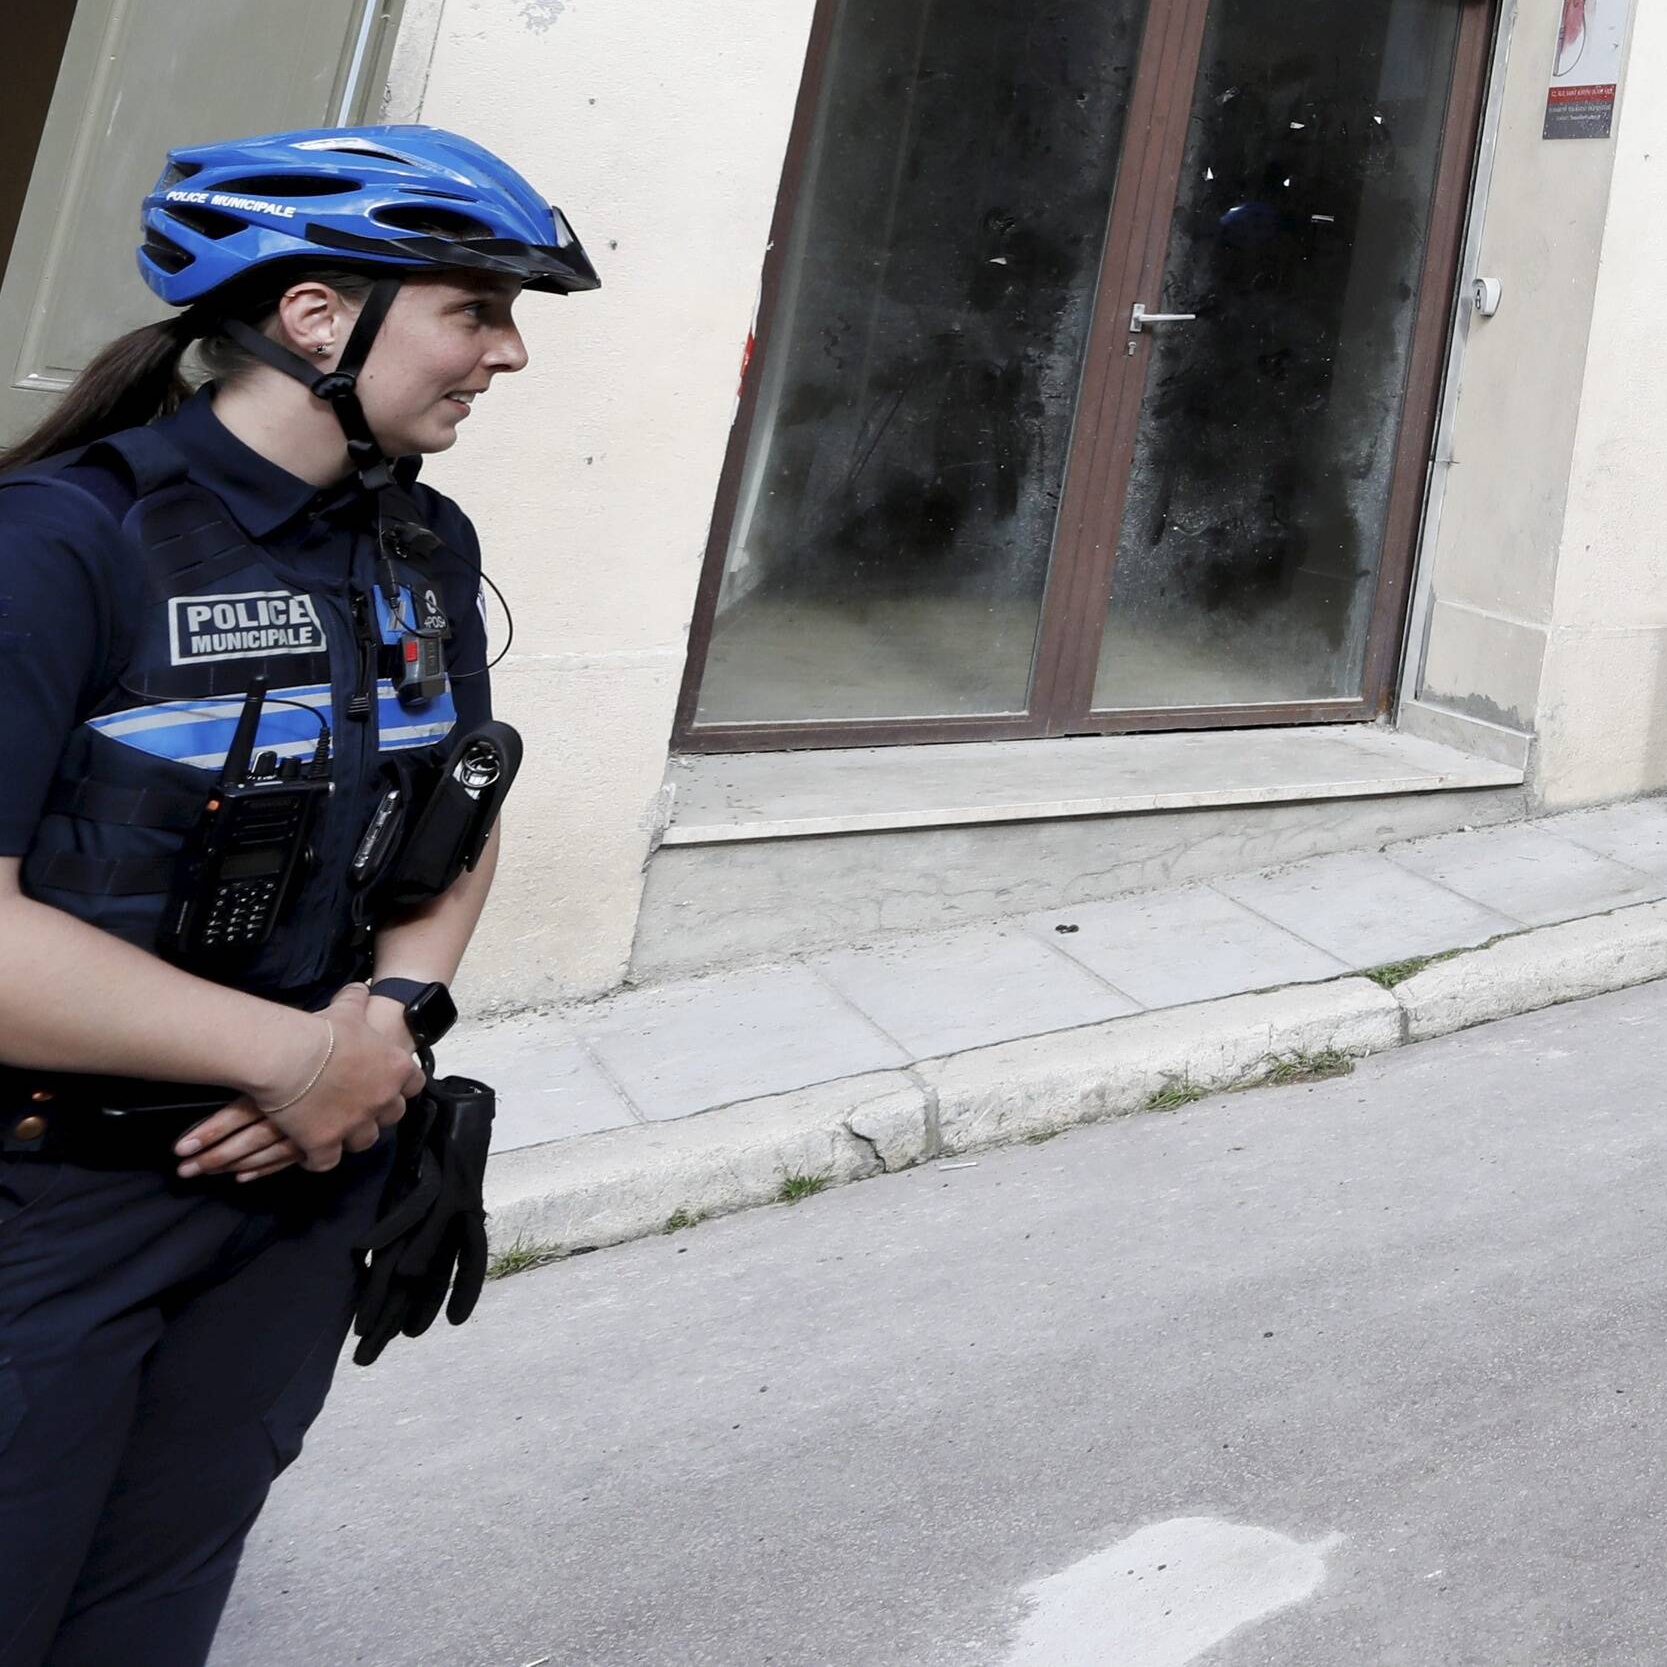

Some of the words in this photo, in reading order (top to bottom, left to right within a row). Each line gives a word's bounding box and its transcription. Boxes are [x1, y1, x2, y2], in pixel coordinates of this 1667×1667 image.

[166, 191, 209, 204] POLICE
[210, 195, 296, 218] MUNICIPALE
[187, 599, 311, 632] POLICE
[191, 627, 313, 654] MUNICIPALE
